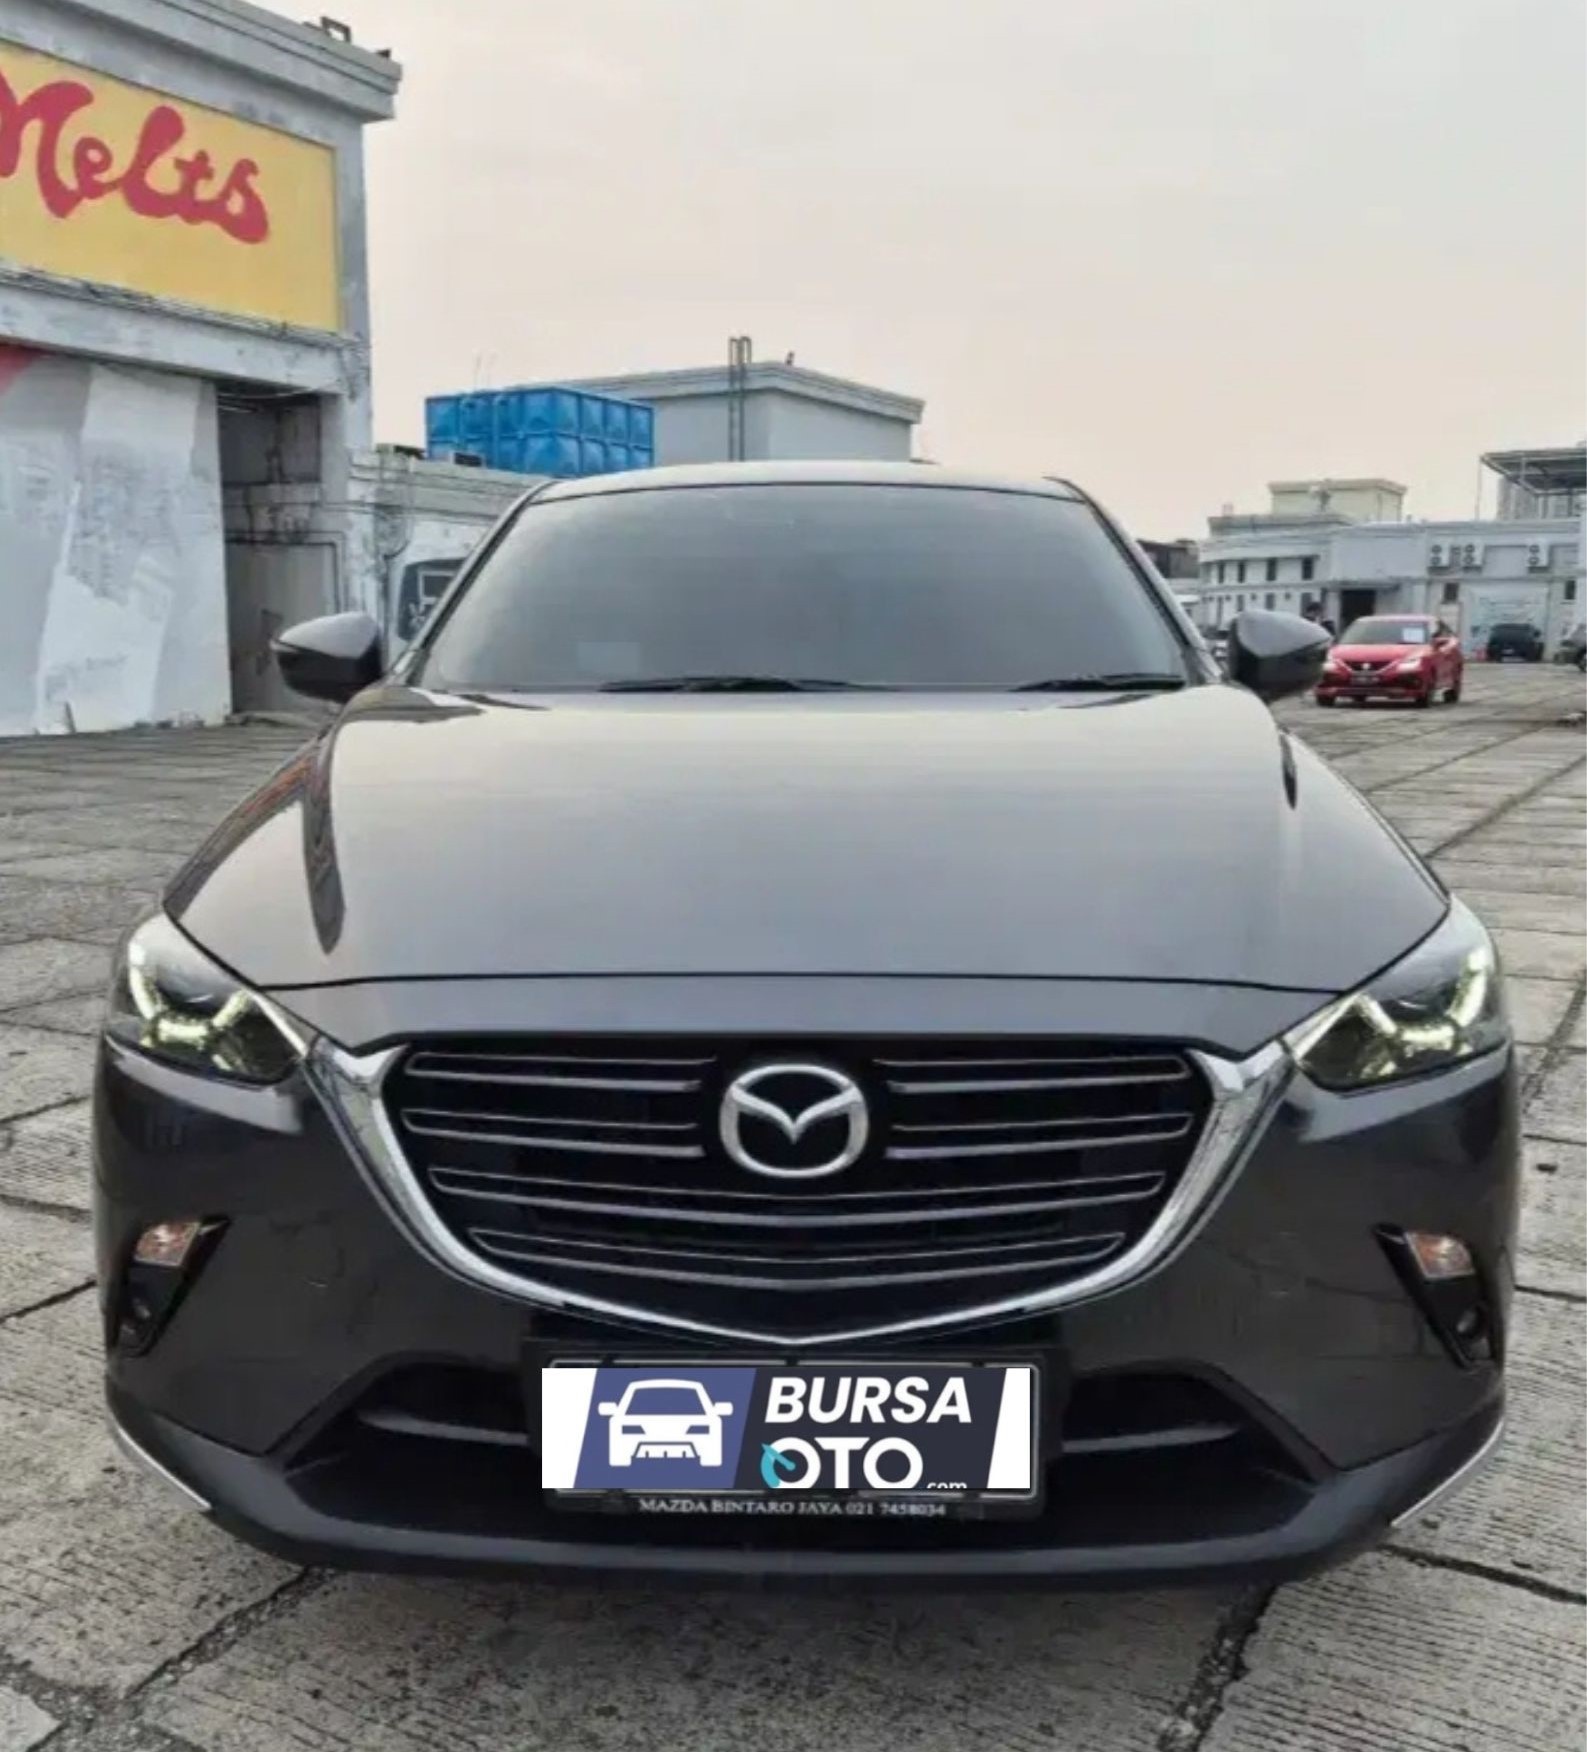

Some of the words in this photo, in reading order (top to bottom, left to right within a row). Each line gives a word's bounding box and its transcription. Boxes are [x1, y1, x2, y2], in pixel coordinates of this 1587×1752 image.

[639, 1499, 708, 1513] MAZDA
[711, 1500, 795, 1514] BINTARO
[798, 1502, 842, 1515] JAYA
[846, 1502, 873, 1515] 021
